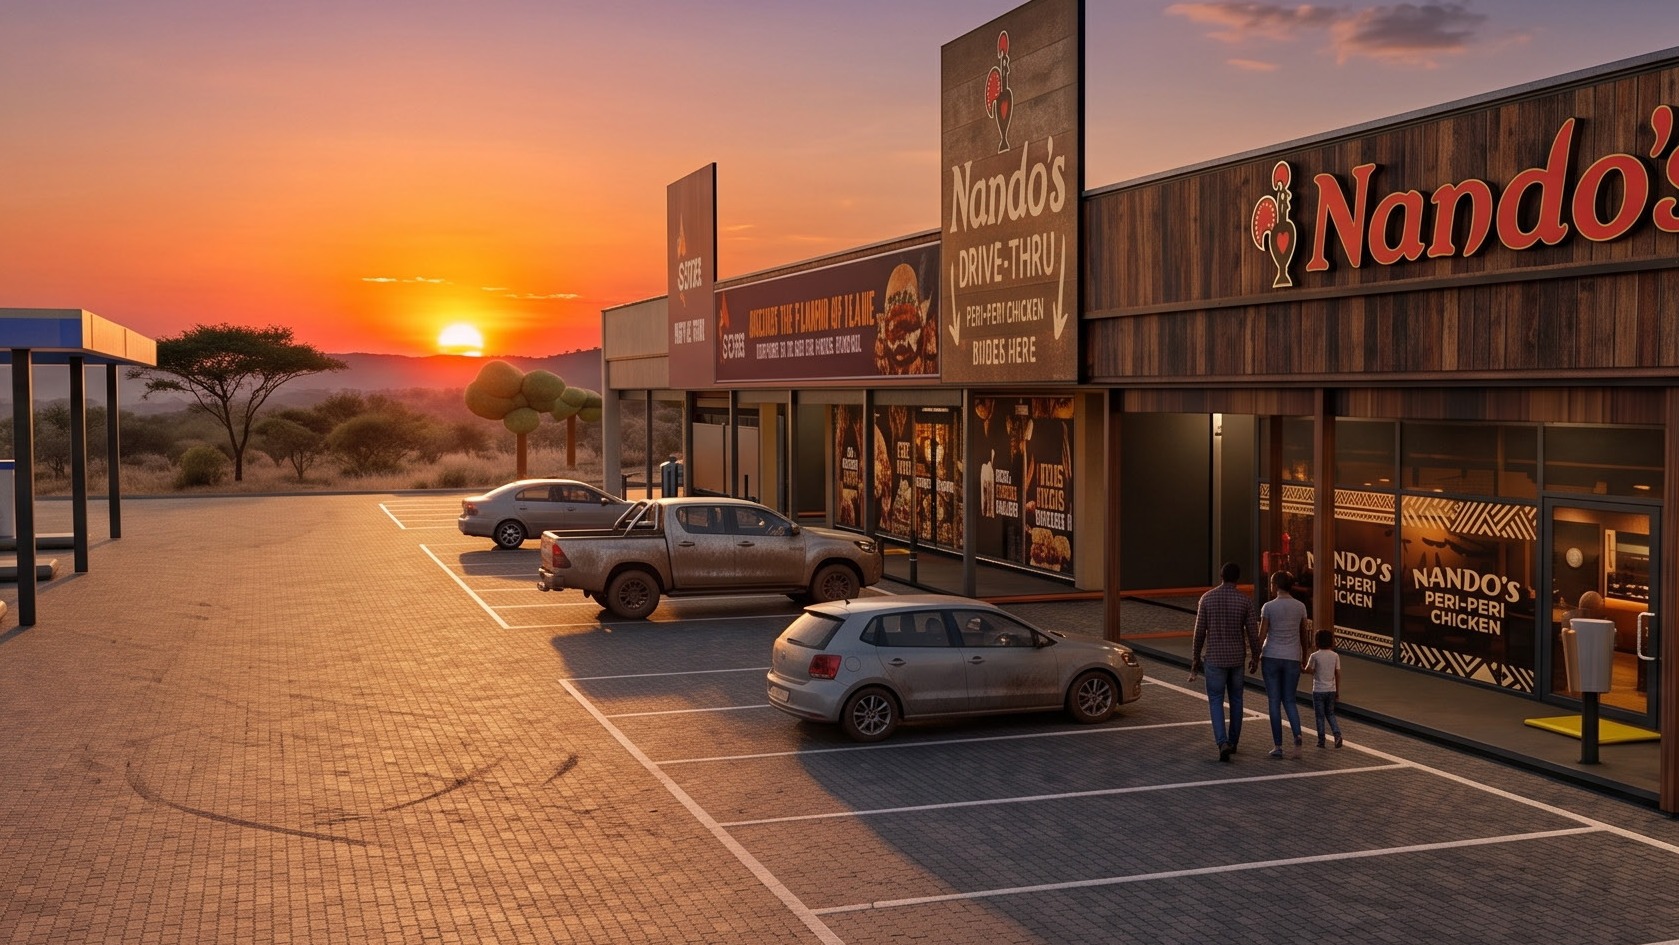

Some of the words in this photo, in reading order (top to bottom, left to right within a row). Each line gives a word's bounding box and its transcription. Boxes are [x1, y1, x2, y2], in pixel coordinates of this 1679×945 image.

[950, 136, 1065, 234] Nando's
[959, 231, 1054, 288] DRIVE-THRU
[966, 302, 1005, 327] PERI-PERI
[1007, 298, 1044, 323] CHICKEN
[1008, 336, 1036, 363] HERE
[1306, 551, 1392, 582] NNDO'S
[1412, 566, 1520, 603] NANDO'S
[1334, 590, 1373, 609] ICKEN
[1425, 590, 1505, 618] PERI-PERI
[1430, 609, 1501, 635] CHICKEN
